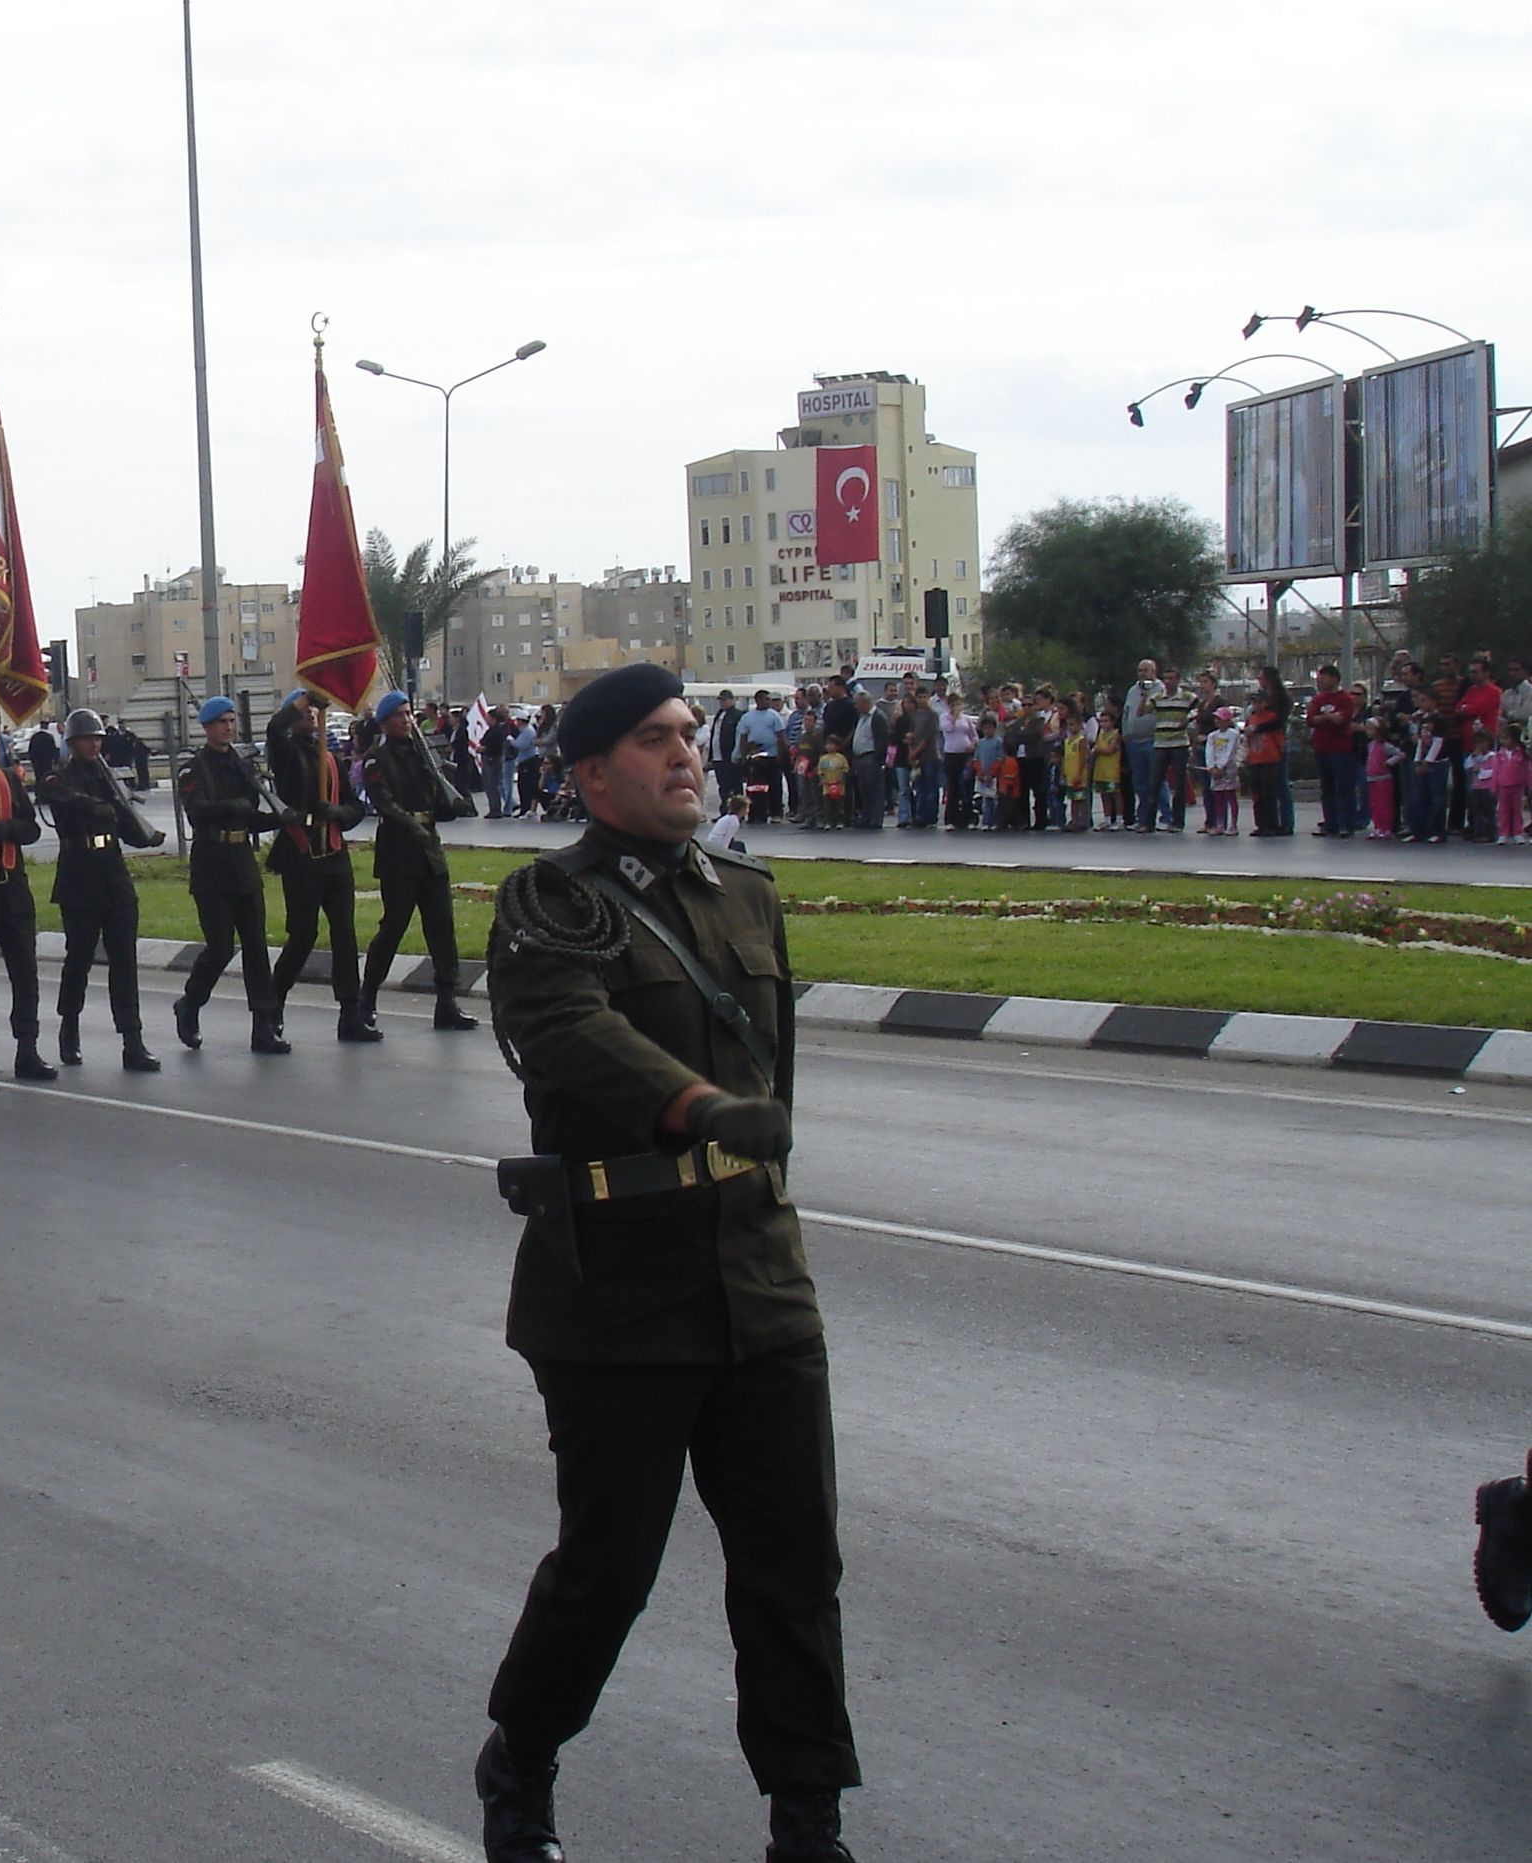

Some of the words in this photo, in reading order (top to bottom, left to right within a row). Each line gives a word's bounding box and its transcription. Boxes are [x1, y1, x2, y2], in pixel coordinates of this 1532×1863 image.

[802, 391, 870, 413] HOSPITAL
[778, 546, 816, 560] CYPR
[778, 565, 832, 584] LIFE
[779, 589, 834, 602] HOSPITAL
